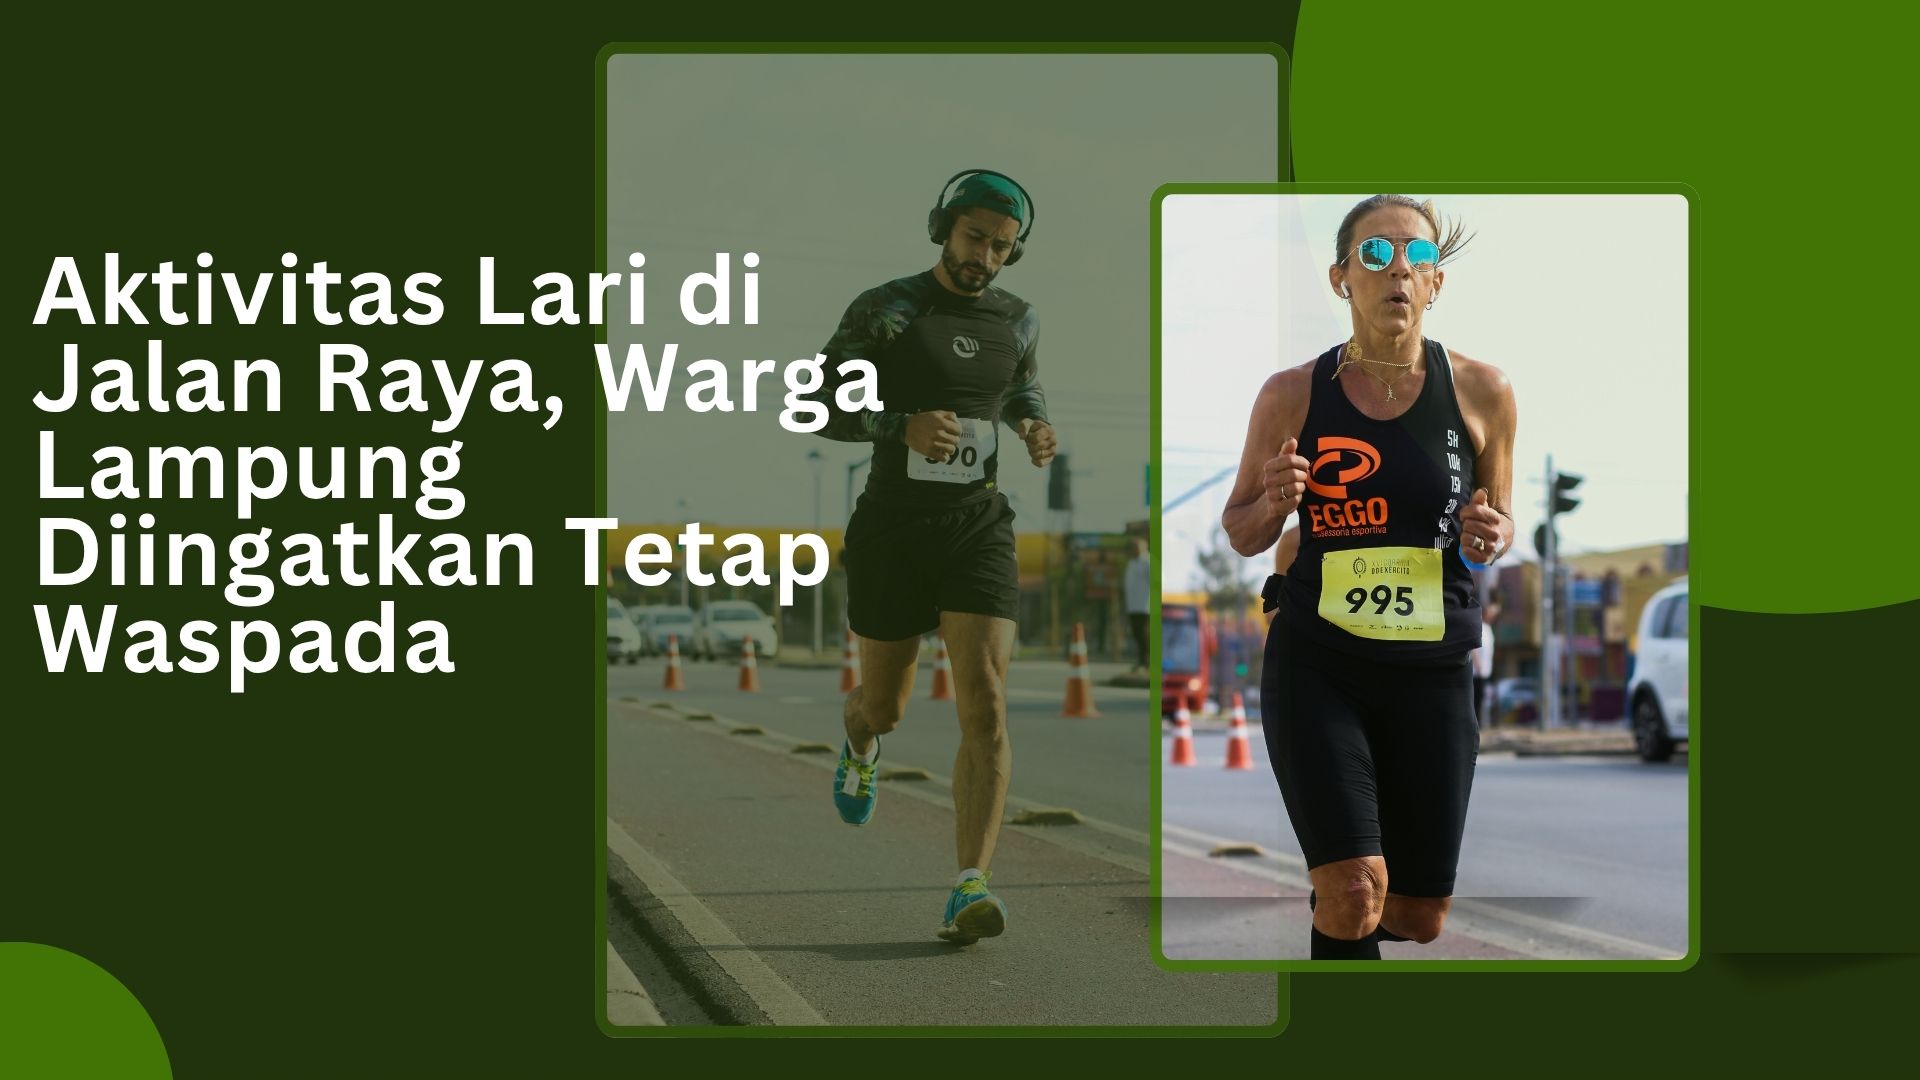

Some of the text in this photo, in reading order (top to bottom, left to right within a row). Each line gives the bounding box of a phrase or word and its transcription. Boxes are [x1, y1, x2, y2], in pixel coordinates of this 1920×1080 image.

[1307, 497, 1388, 532] EGGO
[1352, 525, 1387, 536] esportiva
[1345, 584, 1414, 617] 995
